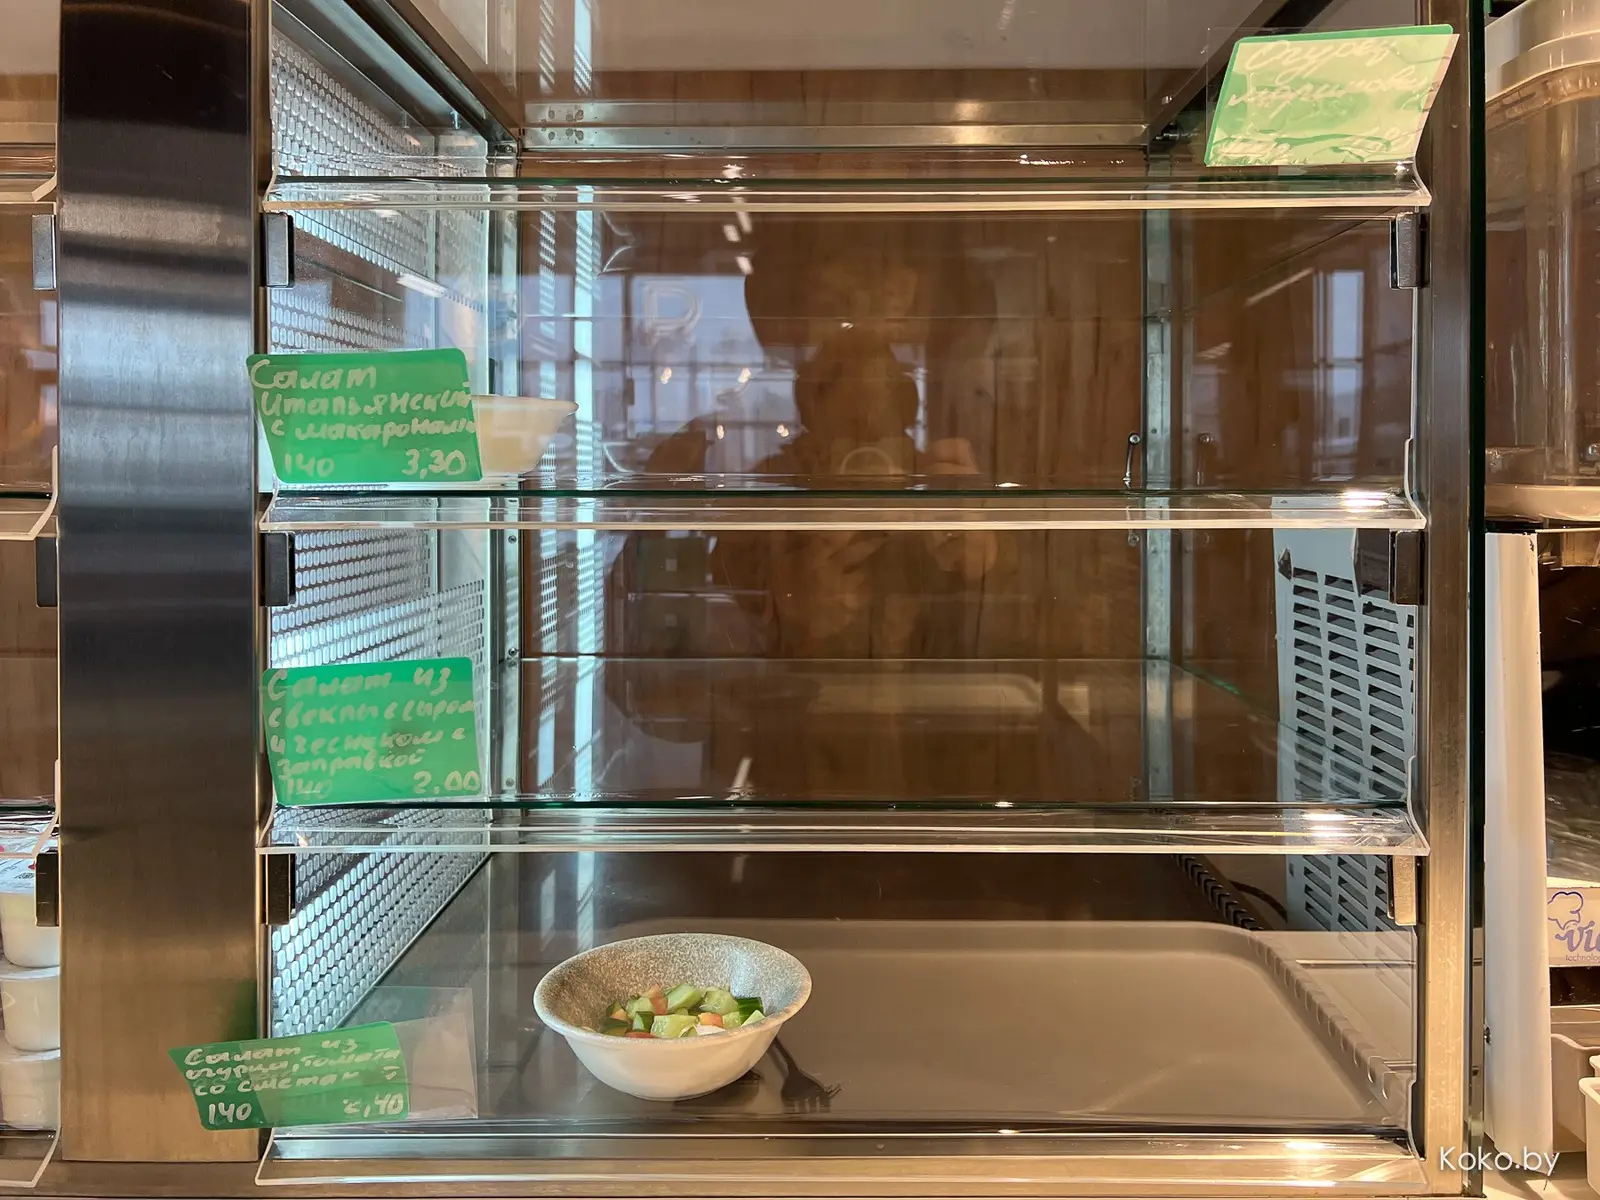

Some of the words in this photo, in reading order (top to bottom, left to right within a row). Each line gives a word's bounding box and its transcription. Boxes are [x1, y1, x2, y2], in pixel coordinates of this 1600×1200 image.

[250, 359, 377, 389] Салат
[271, 419, 285, 436] с
[284, 454, 334, 477] 140
[402, 449, 467, 479] 3,30
[267, 669, 392, 701] Салат
[413, 667, 451, 696] из
[184, 1047, 301, 1066] Салат
[321, 1039, 358, 1054] из
[195, 1083, 226, 1096] со
[208, 1102, 253, 1125] 140
